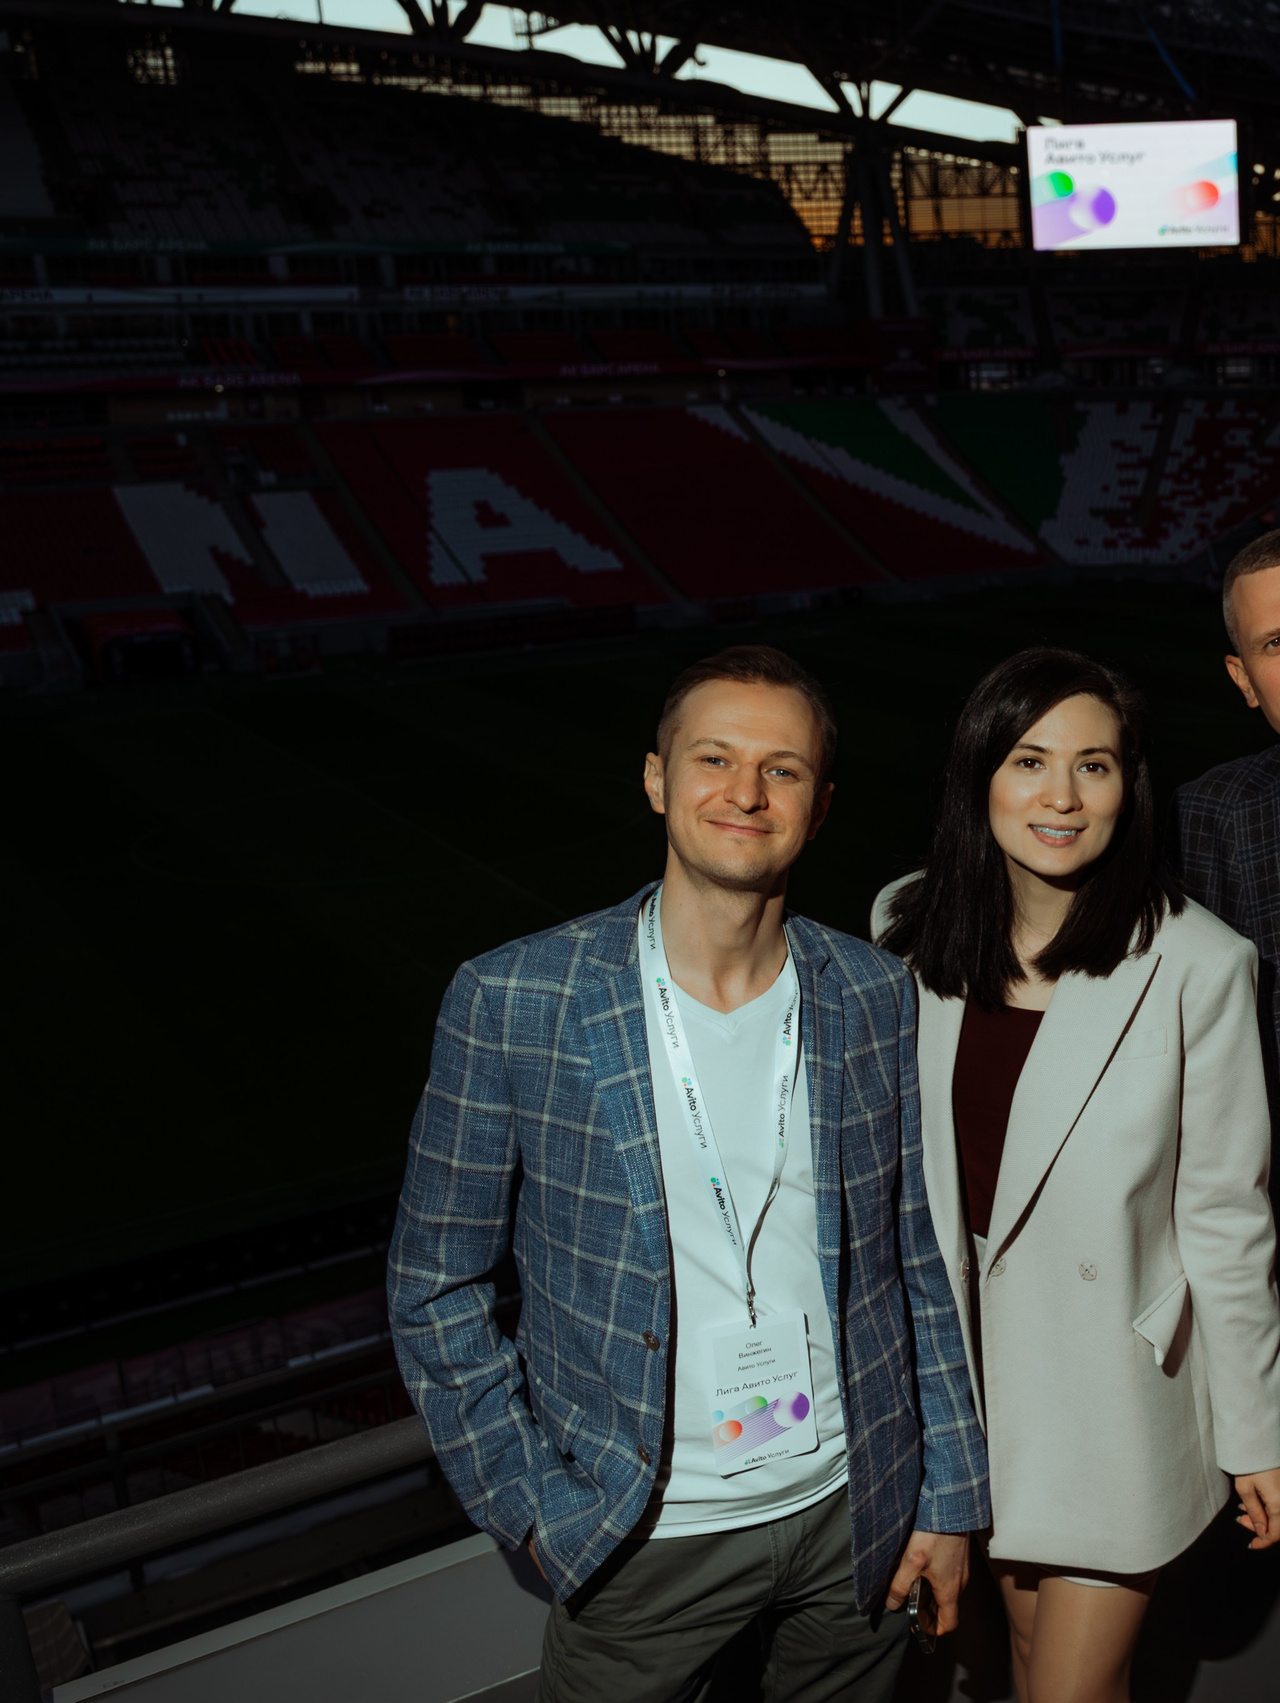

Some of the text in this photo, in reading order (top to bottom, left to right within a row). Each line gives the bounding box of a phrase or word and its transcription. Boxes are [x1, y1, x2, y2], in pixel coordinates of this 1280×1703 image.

[658, 987, 680, 1049] Avito Услуги
[782, 1012, 792, 1036] Avito
[685, 1087, 708, 1149] Avito Услуги
[777, 1075, 790, 1137] Avito Услуги
[714, 1186, 737, 1246] Avito Услуги
[715, 1371, 799, 1397] Лига Авито Услуг
[751, 1455, 767, 1463] Avito
